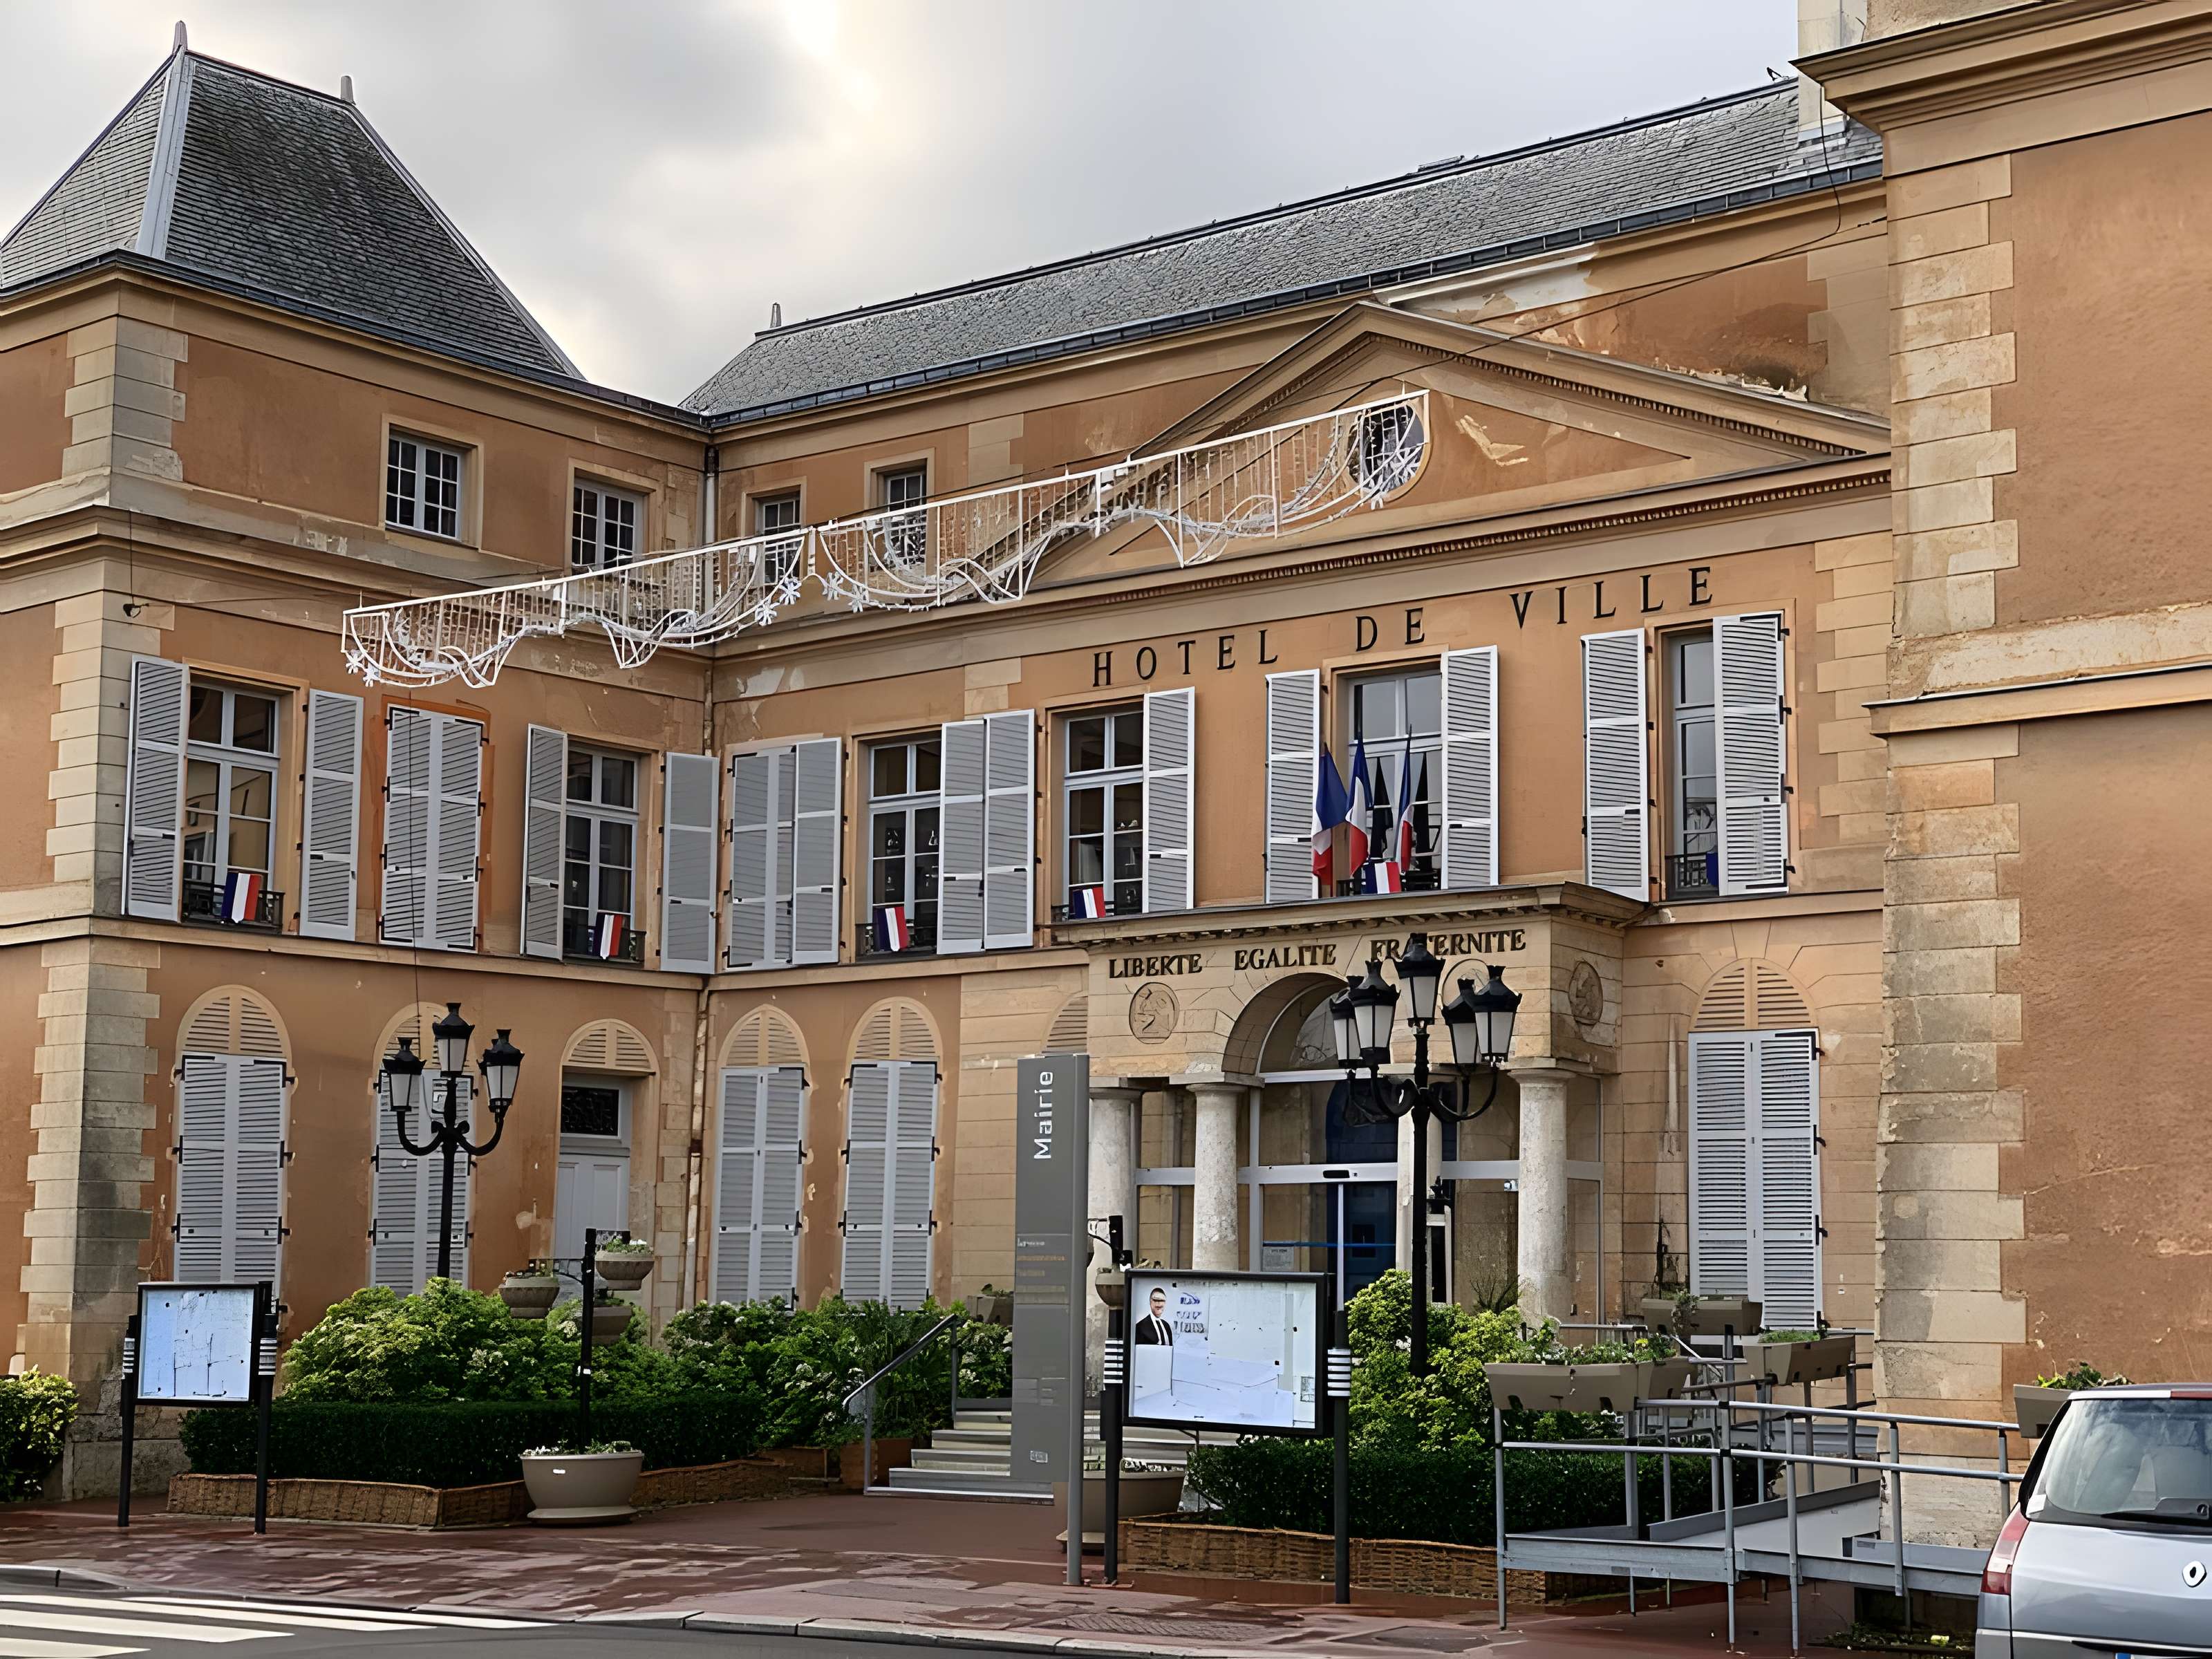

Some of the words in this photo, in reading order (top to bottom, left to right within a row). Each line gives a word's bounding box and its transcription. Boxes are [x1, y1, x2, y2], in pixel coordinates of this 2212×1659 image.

[1092, 628, 1279, 687] HOTEL
[1356, 607, 1425, 653] DE
[1509, 565, 1713, 630] VILLE
[1109, 953, 1203, 979] LIBERTE
[1234, 944, 1337, 971] EGALITE
[1371, 929, 1526, 962] FRERNITE
[1034, 1071, 1053, 1159] Mairie
